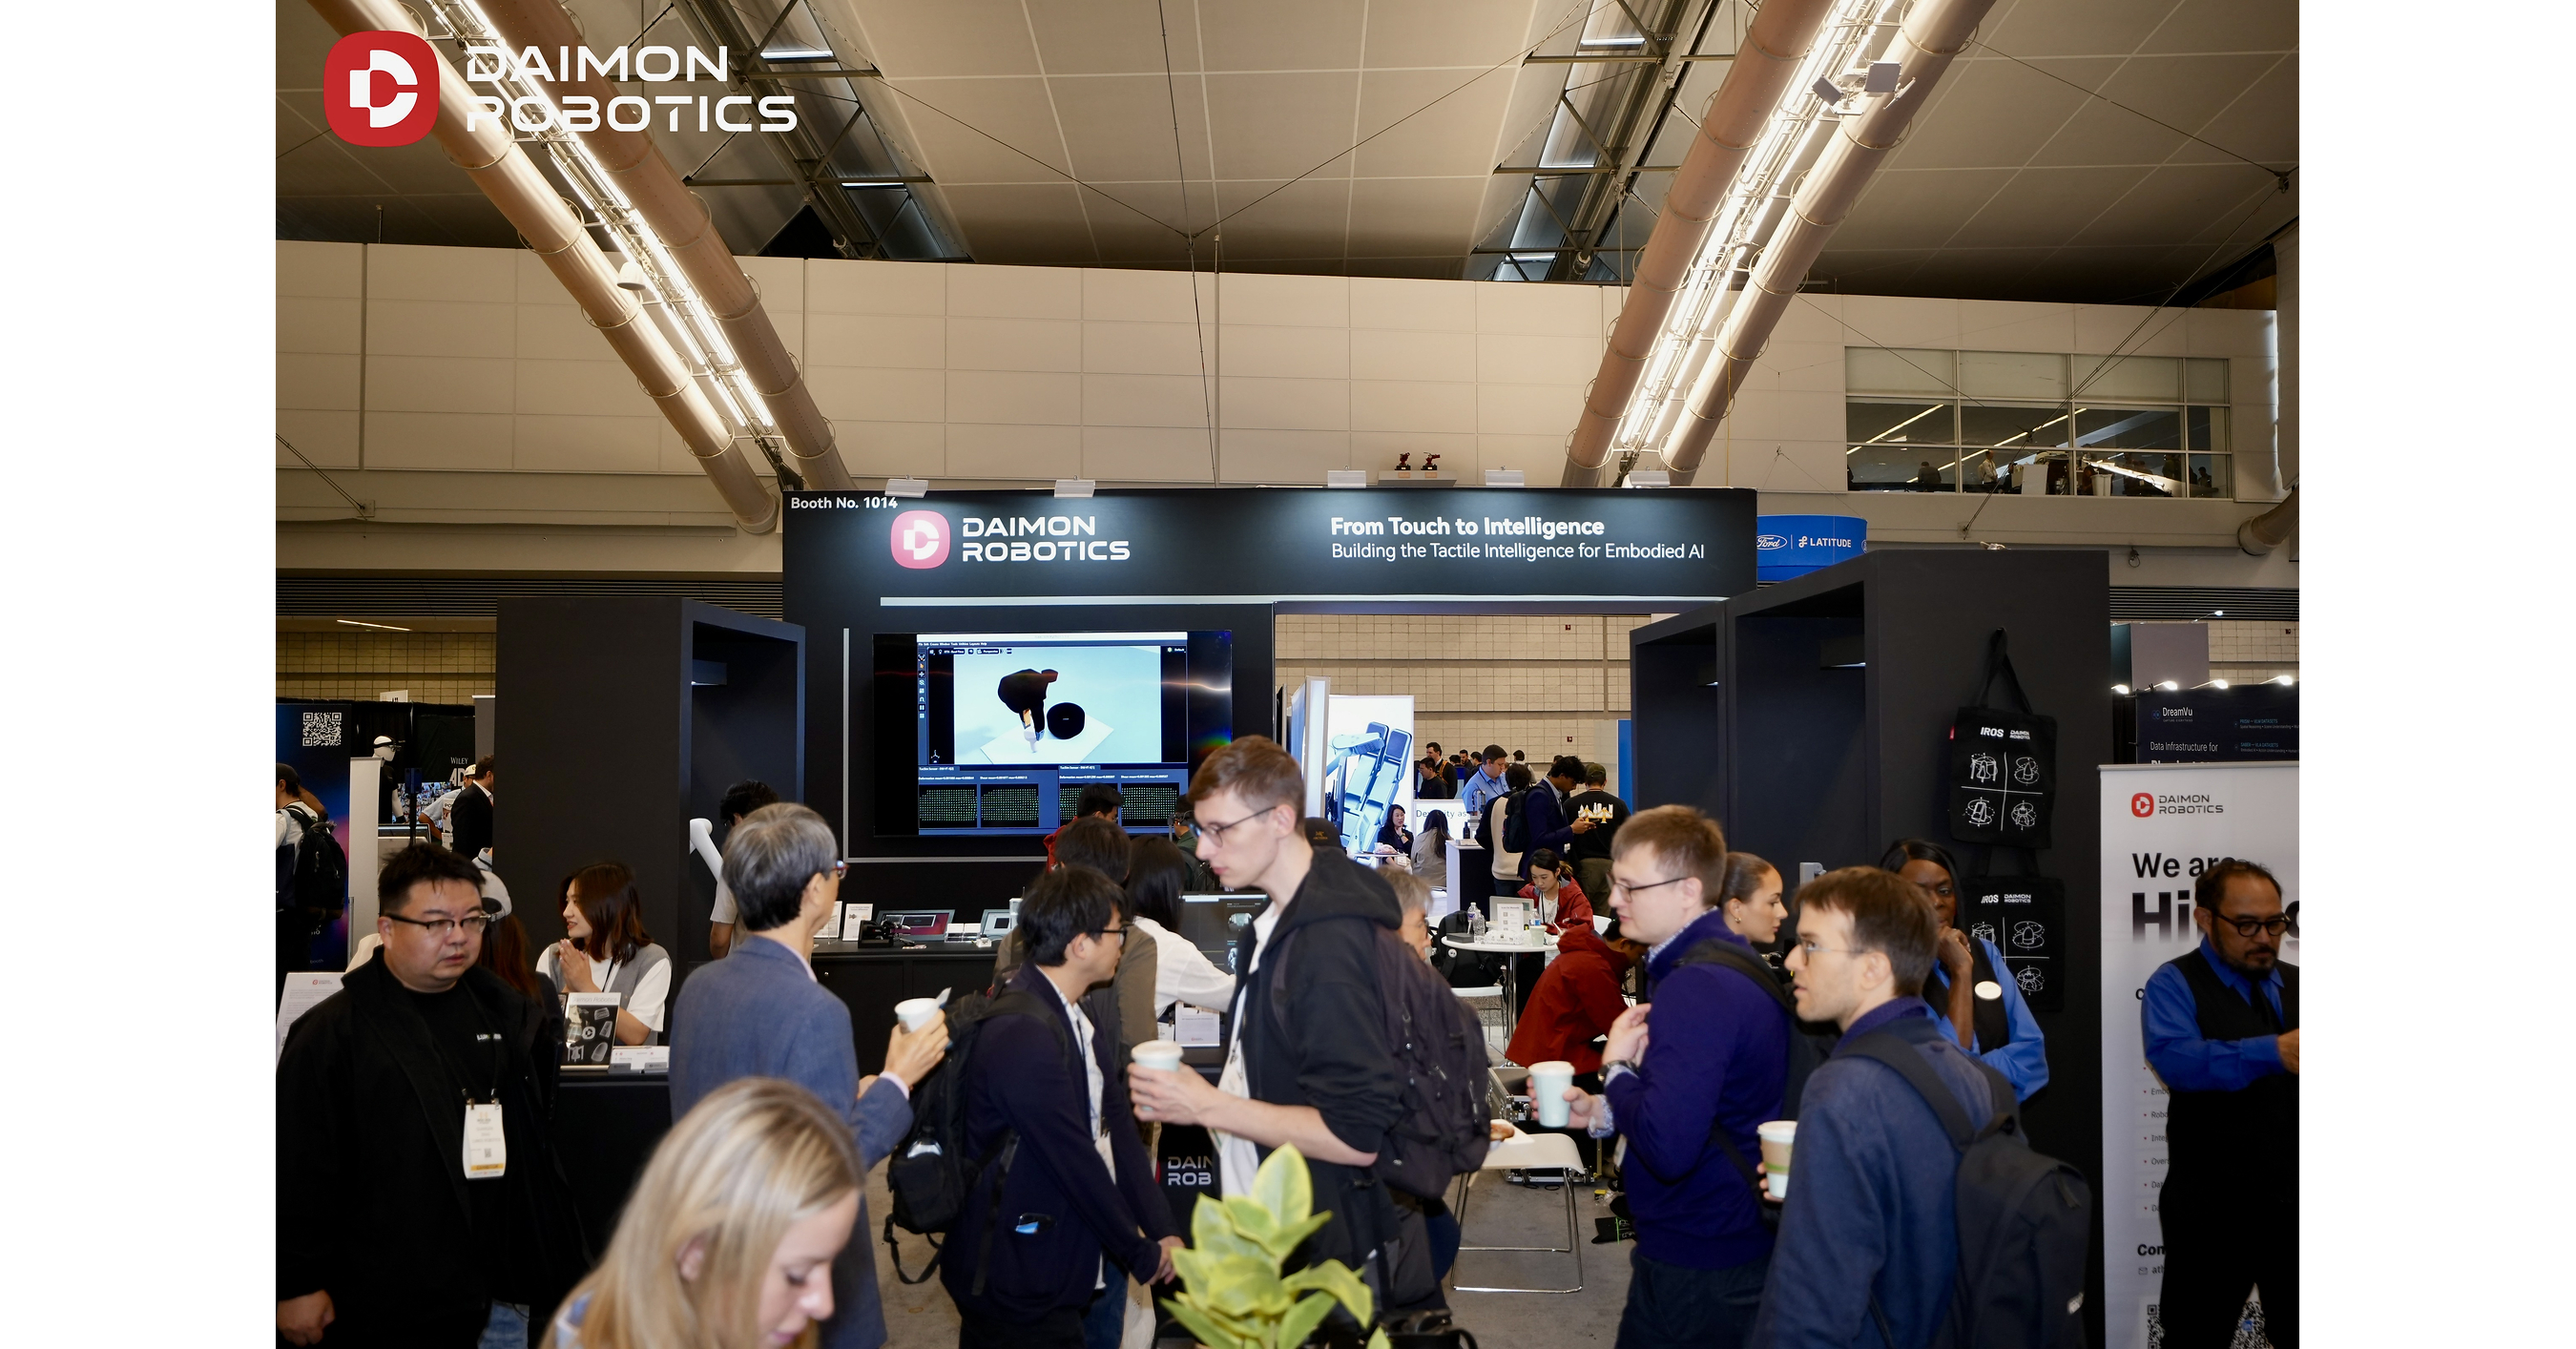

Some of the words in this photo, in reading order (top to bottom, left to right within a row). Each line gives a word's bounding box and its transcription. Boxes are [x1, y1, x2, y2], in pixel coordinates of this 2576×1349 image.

[791, 497, 832, 509] Booth
[836, 497, 860, 509] No.
[863, 496, 898, 509] 1014
[962, 516, 1095, 536] DAIMON
[1331, 517, 1384, 535] From
[1388, 516, 1449, 535] Touch
[1455, 519, 1478, 535] to
[1484, 516, 1605, 540] Intelligence
[1756, 536, 1780, 548] Ford
[1810, 537, 1851, 548] LATITUDE
[962, 540, 1131, 562] ROBOTICS
[1332, 542, 1396, 562] Building
[1401, 543, 1426, 558] the
[1430, 543, 1480, 558] Tactile
[1485, 543, 1574, 561] Intelligence
[1577, 543, 1601, 558] for
[1605, 543, 1685, 558] Embodied
[1689, 544, 1705, 559] AI
[2162, 707, 2193, 716] DreamVu
[1980, 727, 2004, 737] IROS
[2150, 742, 2164, 750] Data
[2166, 742, 2207, 751] Infrastructure
[2209, 742, 2218, 751] for
[2159, 795, 2210, 803] DAIMON
[2159, 805, 2223, 814] ROBOTICS
[2132, 853, 2180, 878] We
[2189, 857, 2236, 877] ar
[1981, 894, 1999, 903] IROS
